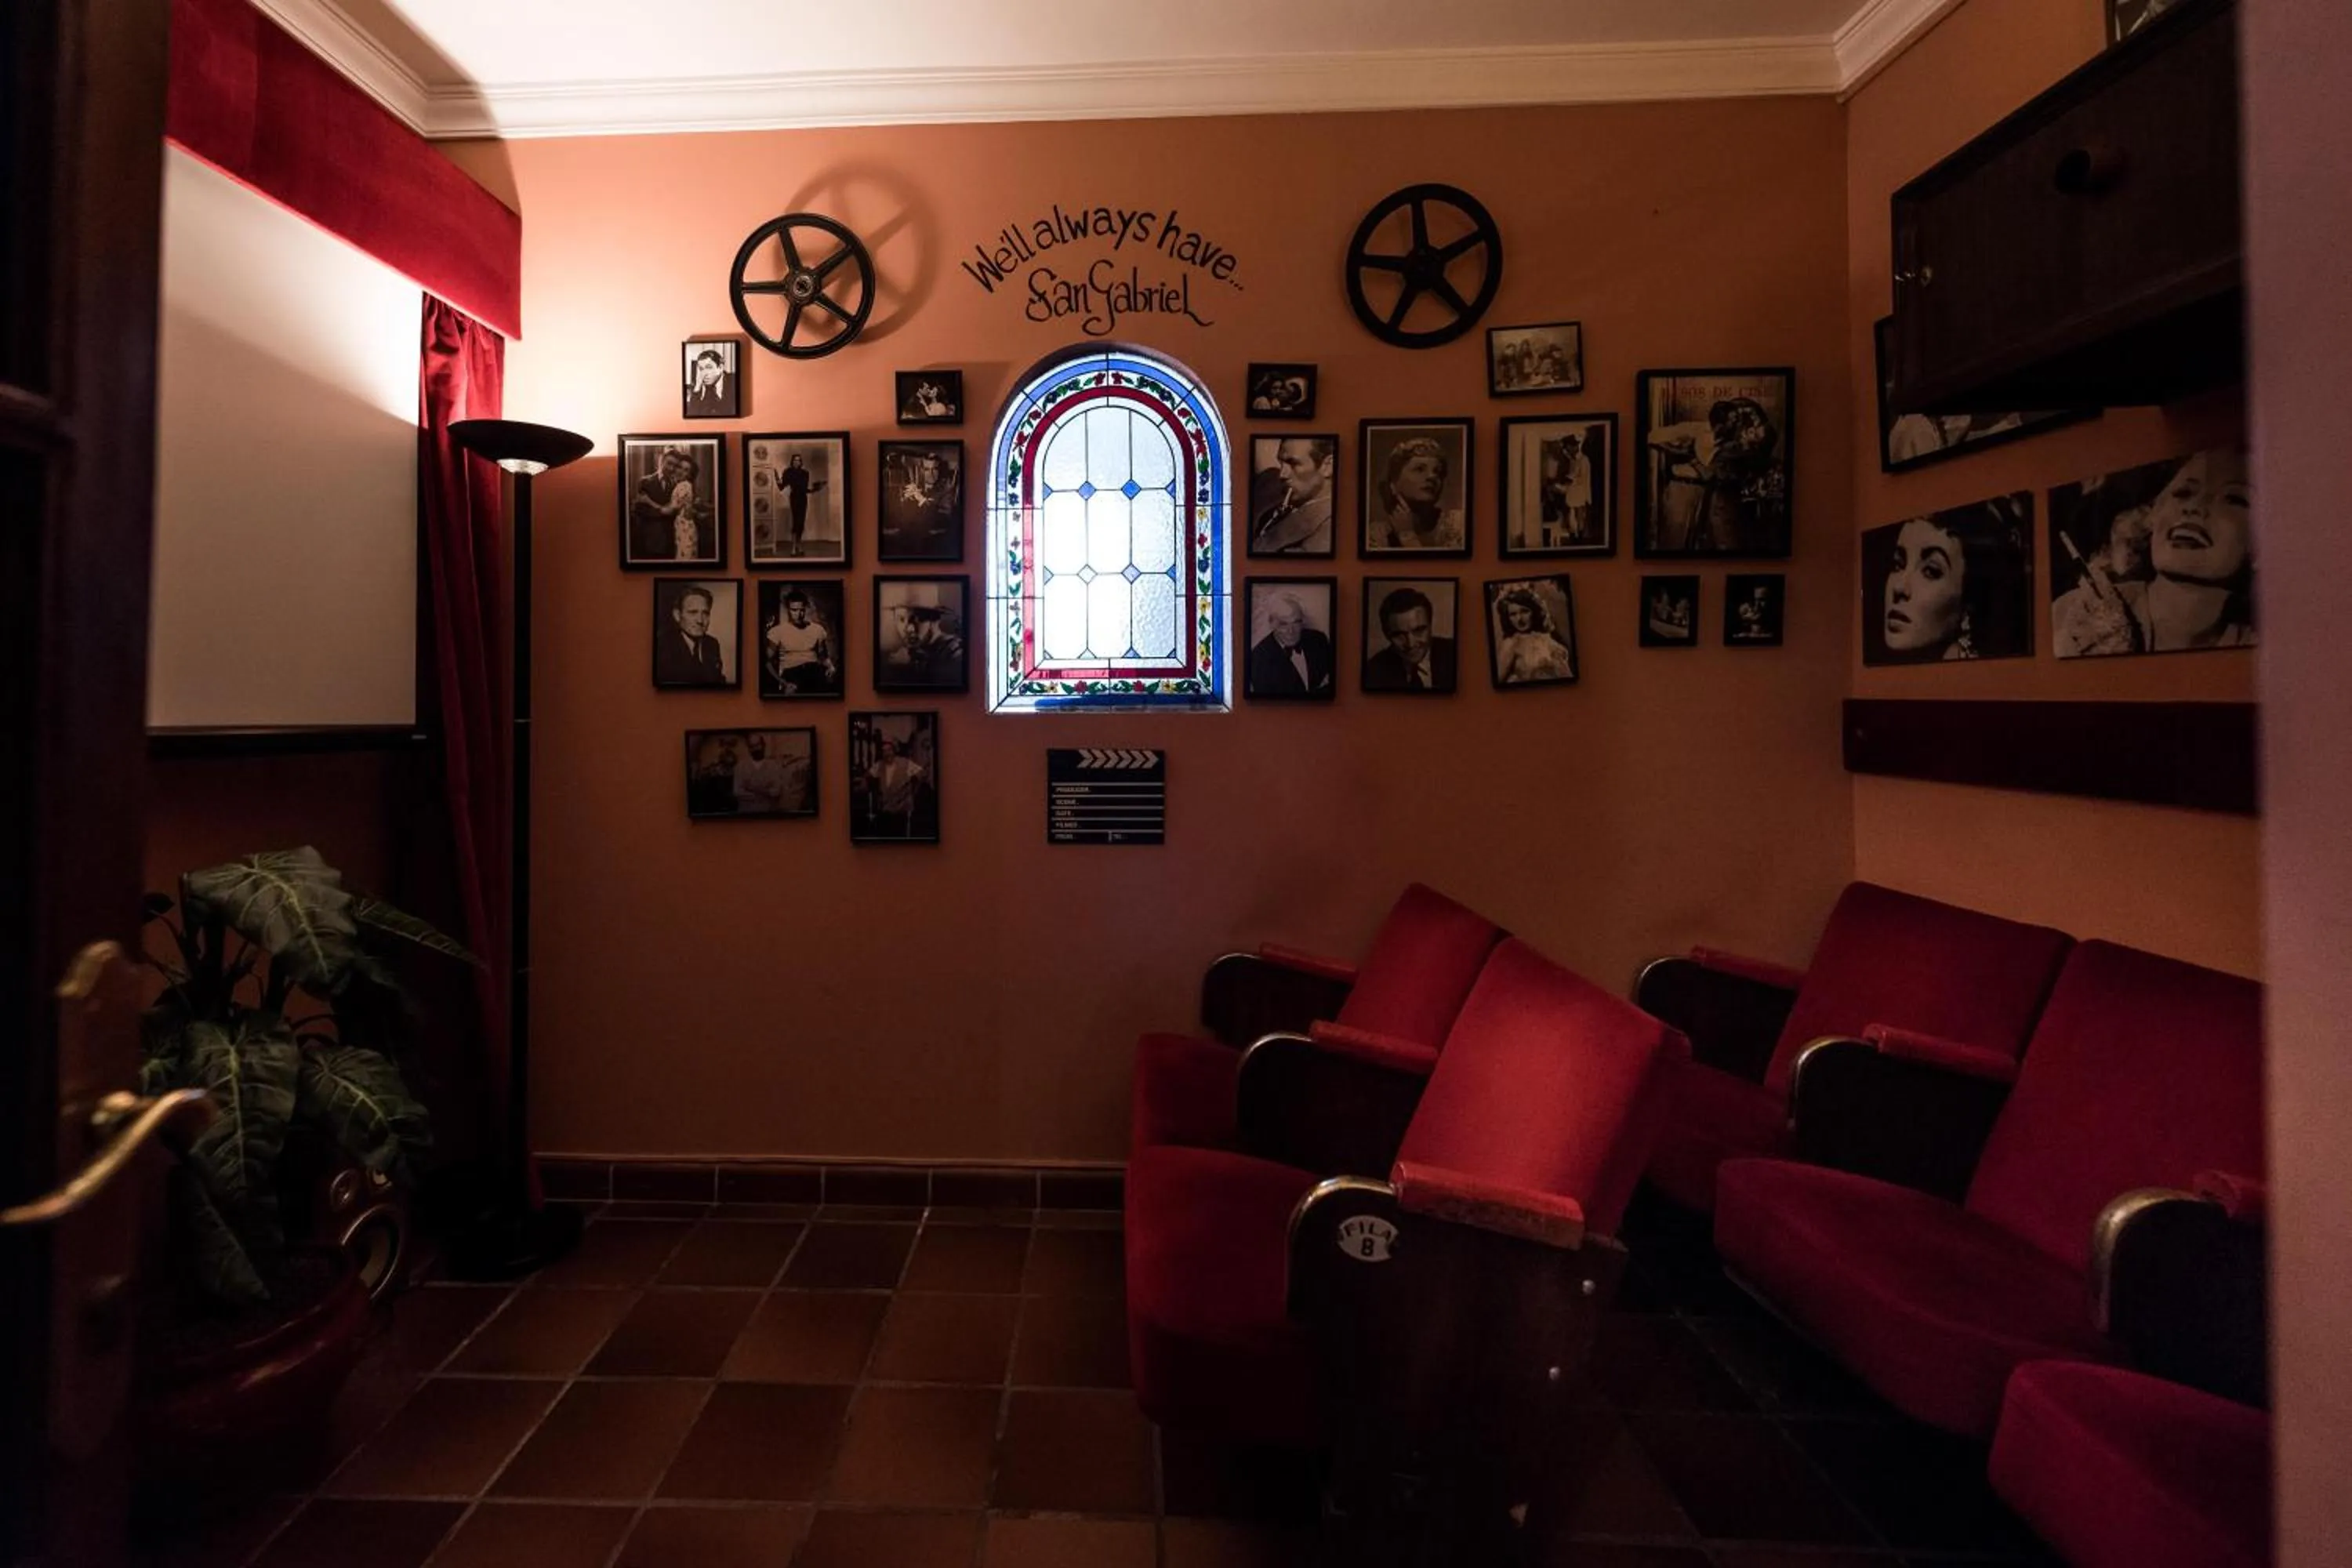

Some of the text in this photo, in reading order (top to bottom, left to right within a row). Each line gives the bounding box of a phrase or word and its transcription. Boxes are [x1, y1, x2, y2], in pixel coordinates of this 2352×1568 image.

[1033, 205, 1156, 251] always
[1025, 260, 1215, 336] San Gabriel
[1344, 1221, 1392, 1242] FILA
